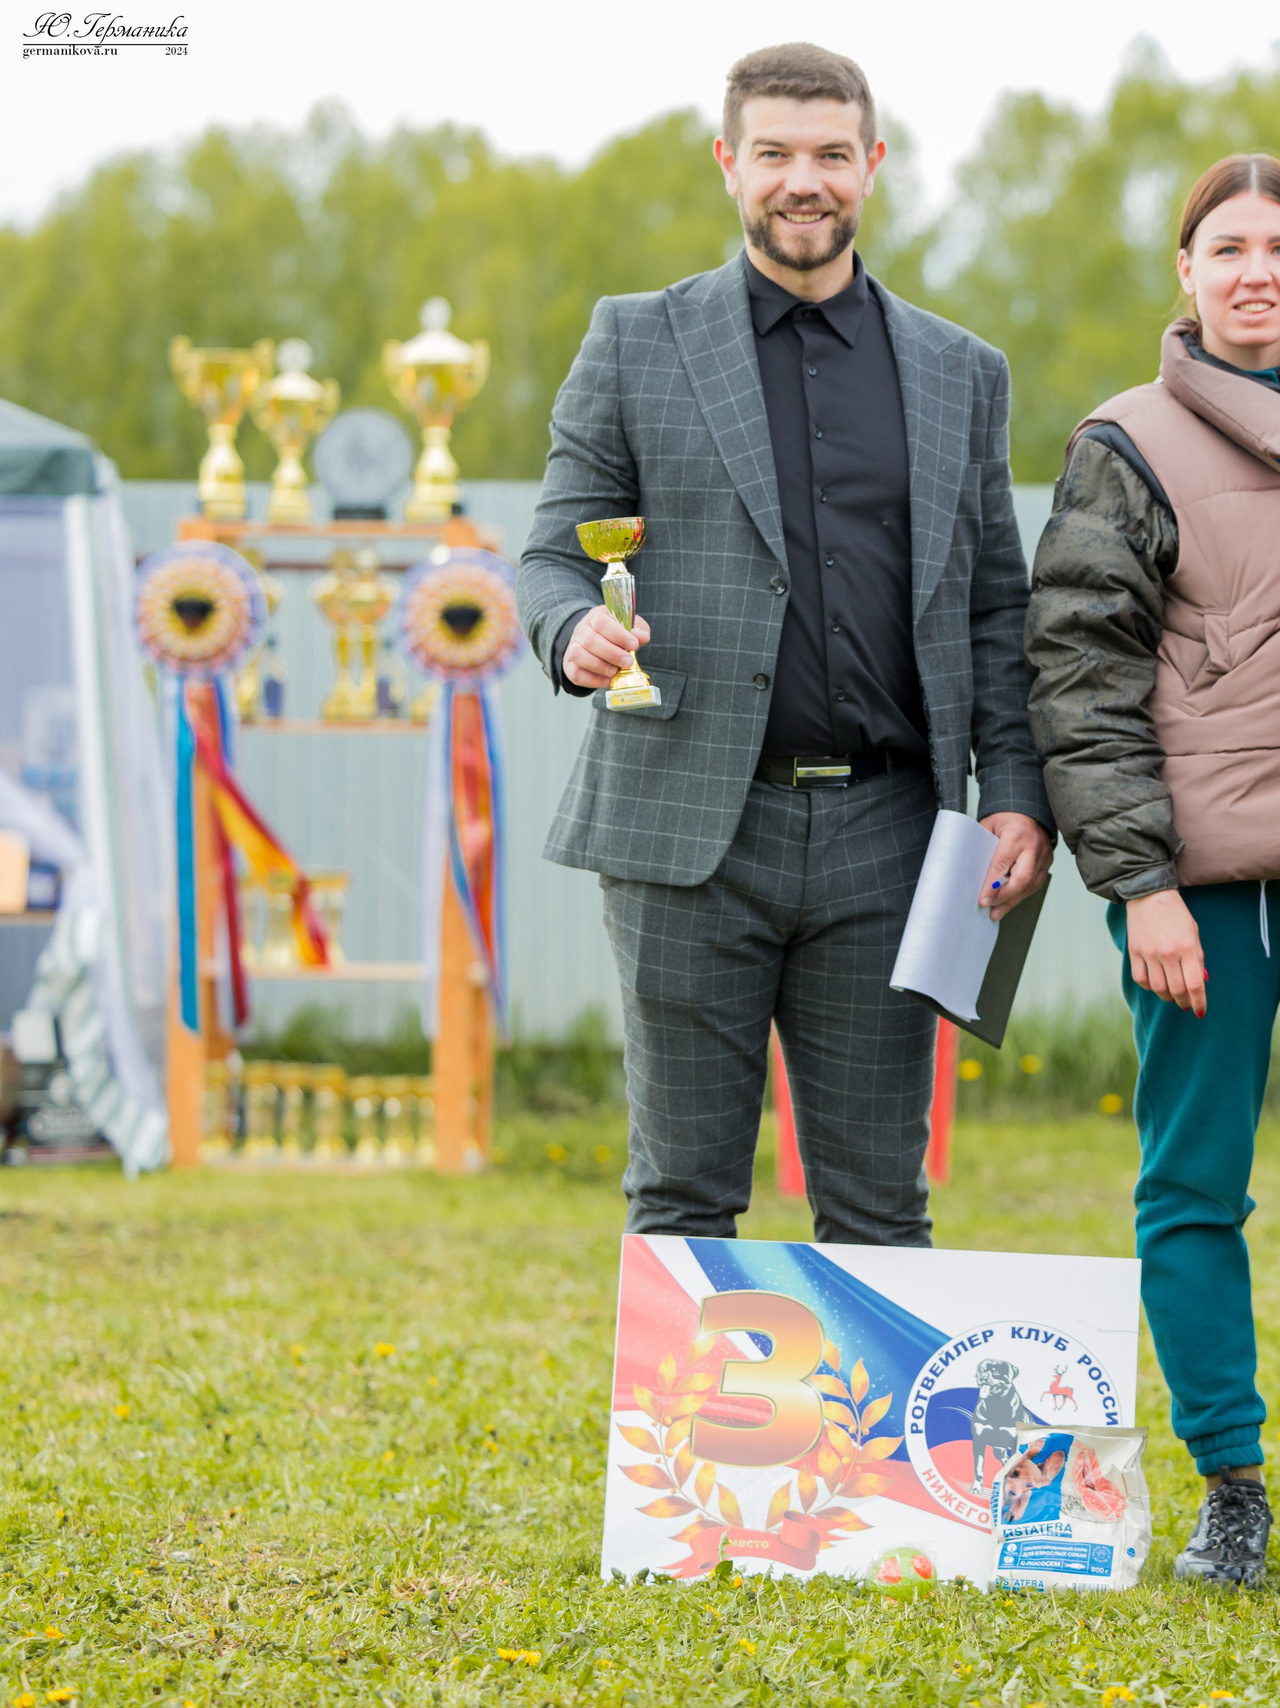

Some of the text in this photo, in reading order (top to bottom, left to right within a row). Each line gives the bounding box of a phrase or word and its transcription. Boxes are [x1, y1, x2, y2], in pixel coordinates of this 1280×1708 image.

[690, 1289, 825, 1469] 3
[911, 1329, 994, 1434] РОТВЕЙЛЕР
[1011, 1326, 1069, 1352] КЛУБ
[1014, 1522, 1072, 1536] STATERA
